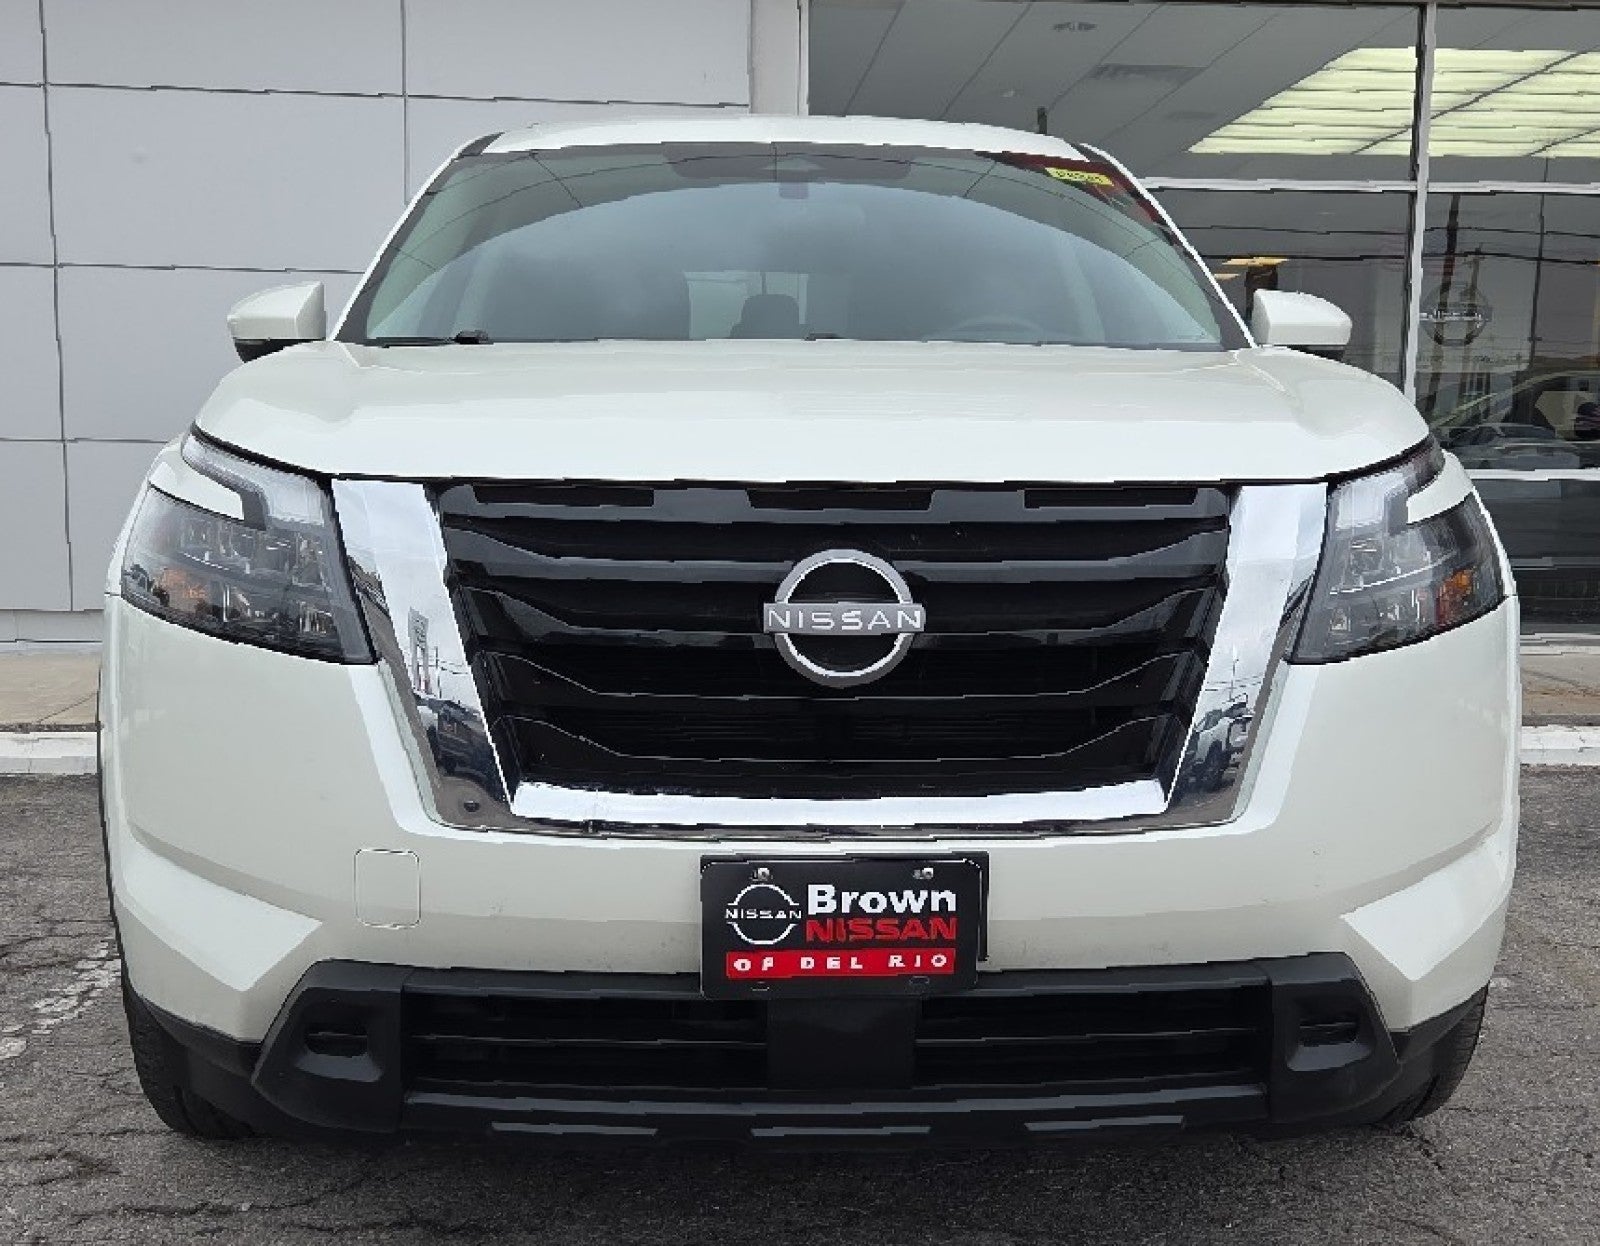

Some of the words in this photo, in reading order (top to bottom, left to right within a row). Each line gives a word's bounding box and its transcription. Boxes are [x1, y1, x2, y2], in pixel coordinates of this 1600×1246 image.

[768, 610, 921, 631] NISSAN
[807, 884, 957, 915] Brown
[725, 908, 802, 920] NISSAN
[805, 918, 958, 942] NISSAN
[733, 956, 774, 972] OF
[800, 956, 863, 971] DEL
[888, 954, 948, 968] RIO
